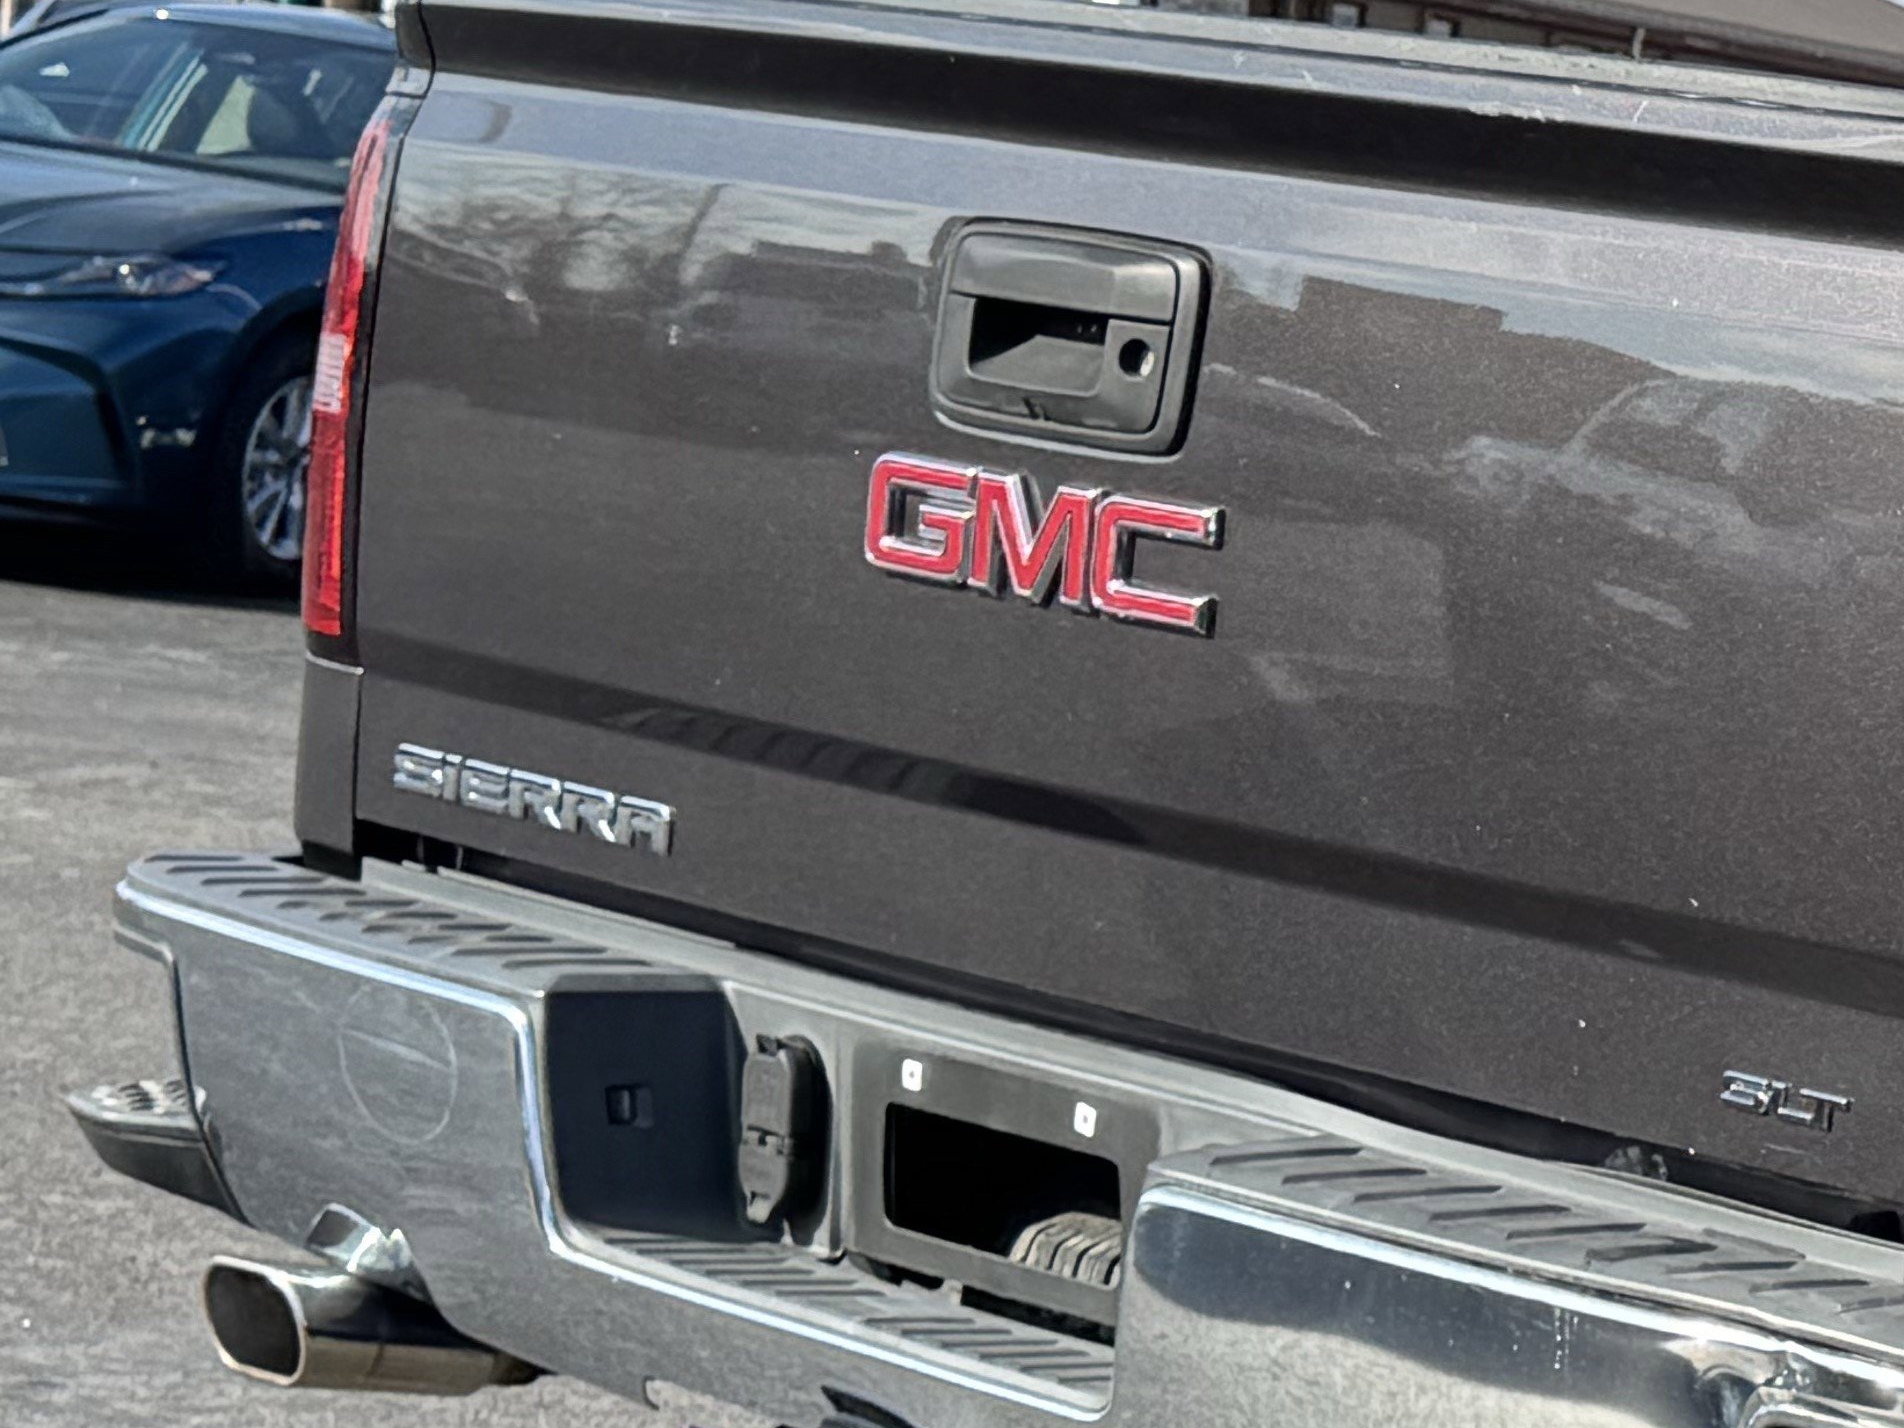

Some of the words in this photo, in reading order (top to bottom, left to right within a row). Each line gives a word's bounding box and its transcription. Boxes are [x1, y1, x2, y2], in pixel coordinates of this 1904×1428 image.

[864, 450, 1226, 640] GMC
[393, 742, 676, 858] SIERRA
[1720, 1068, 1855, 1133] SLT
